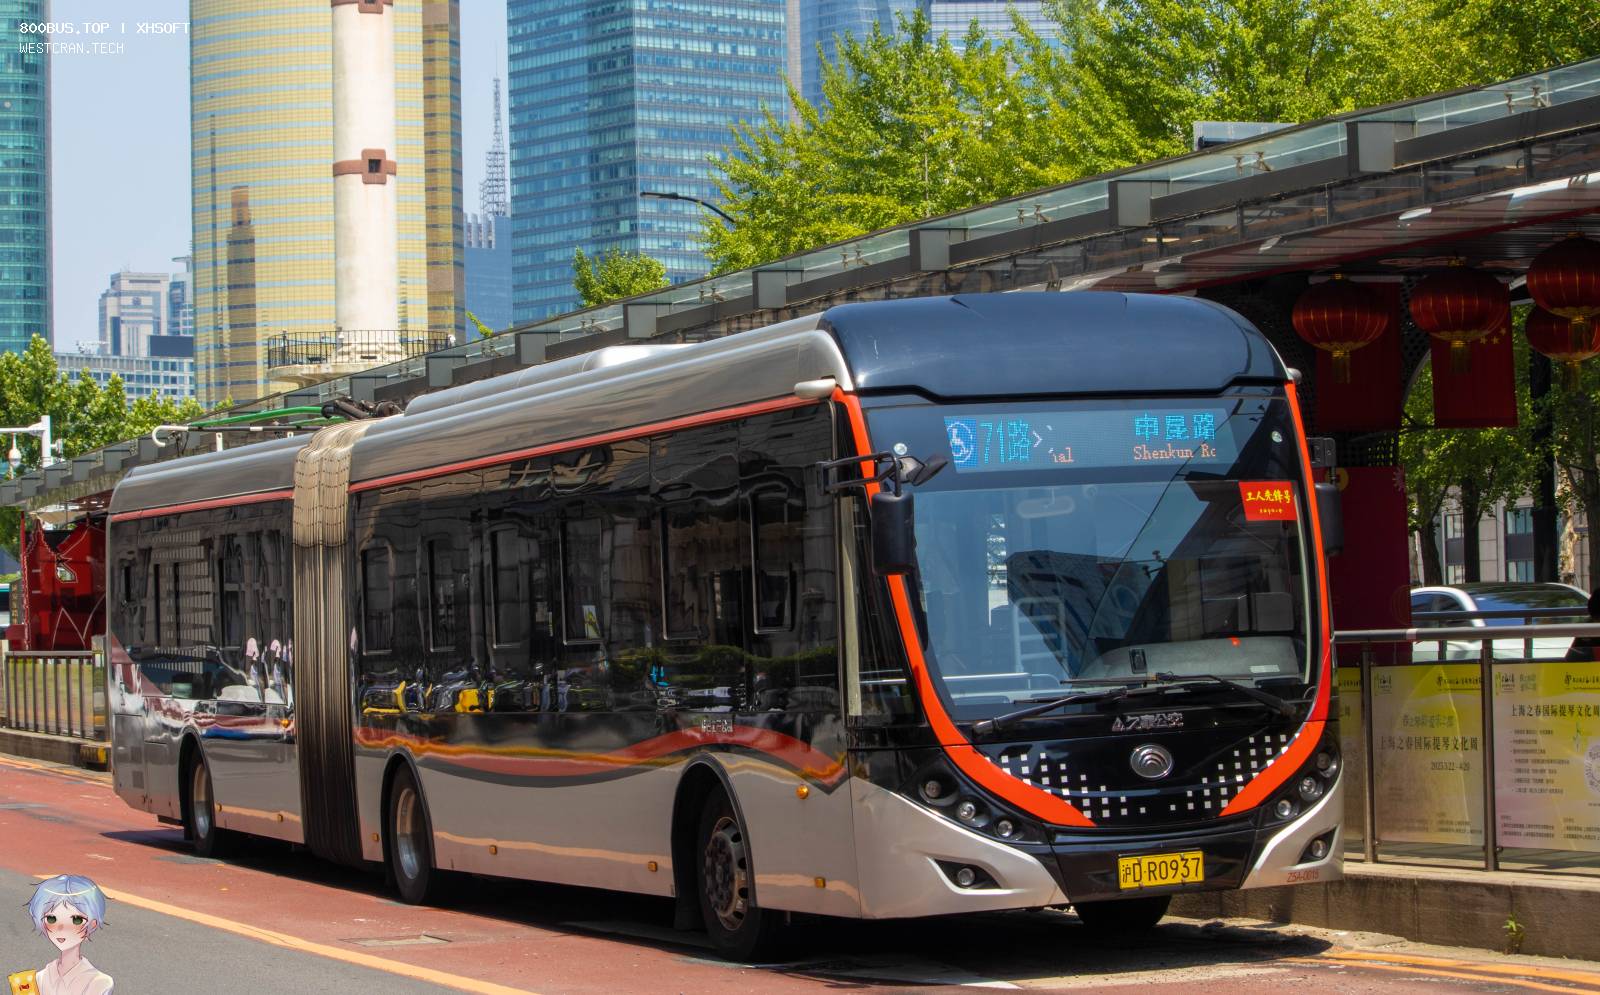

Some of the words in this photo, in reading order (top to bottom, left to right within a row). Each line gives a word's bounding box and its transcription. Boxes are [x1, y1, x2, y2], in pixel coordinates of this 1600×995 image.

[979, 419, 1031, 464] 71路
[1133, 443, 1194, 460] Shenkun
[1246, 489, 1291, 504] 工人先锋号
